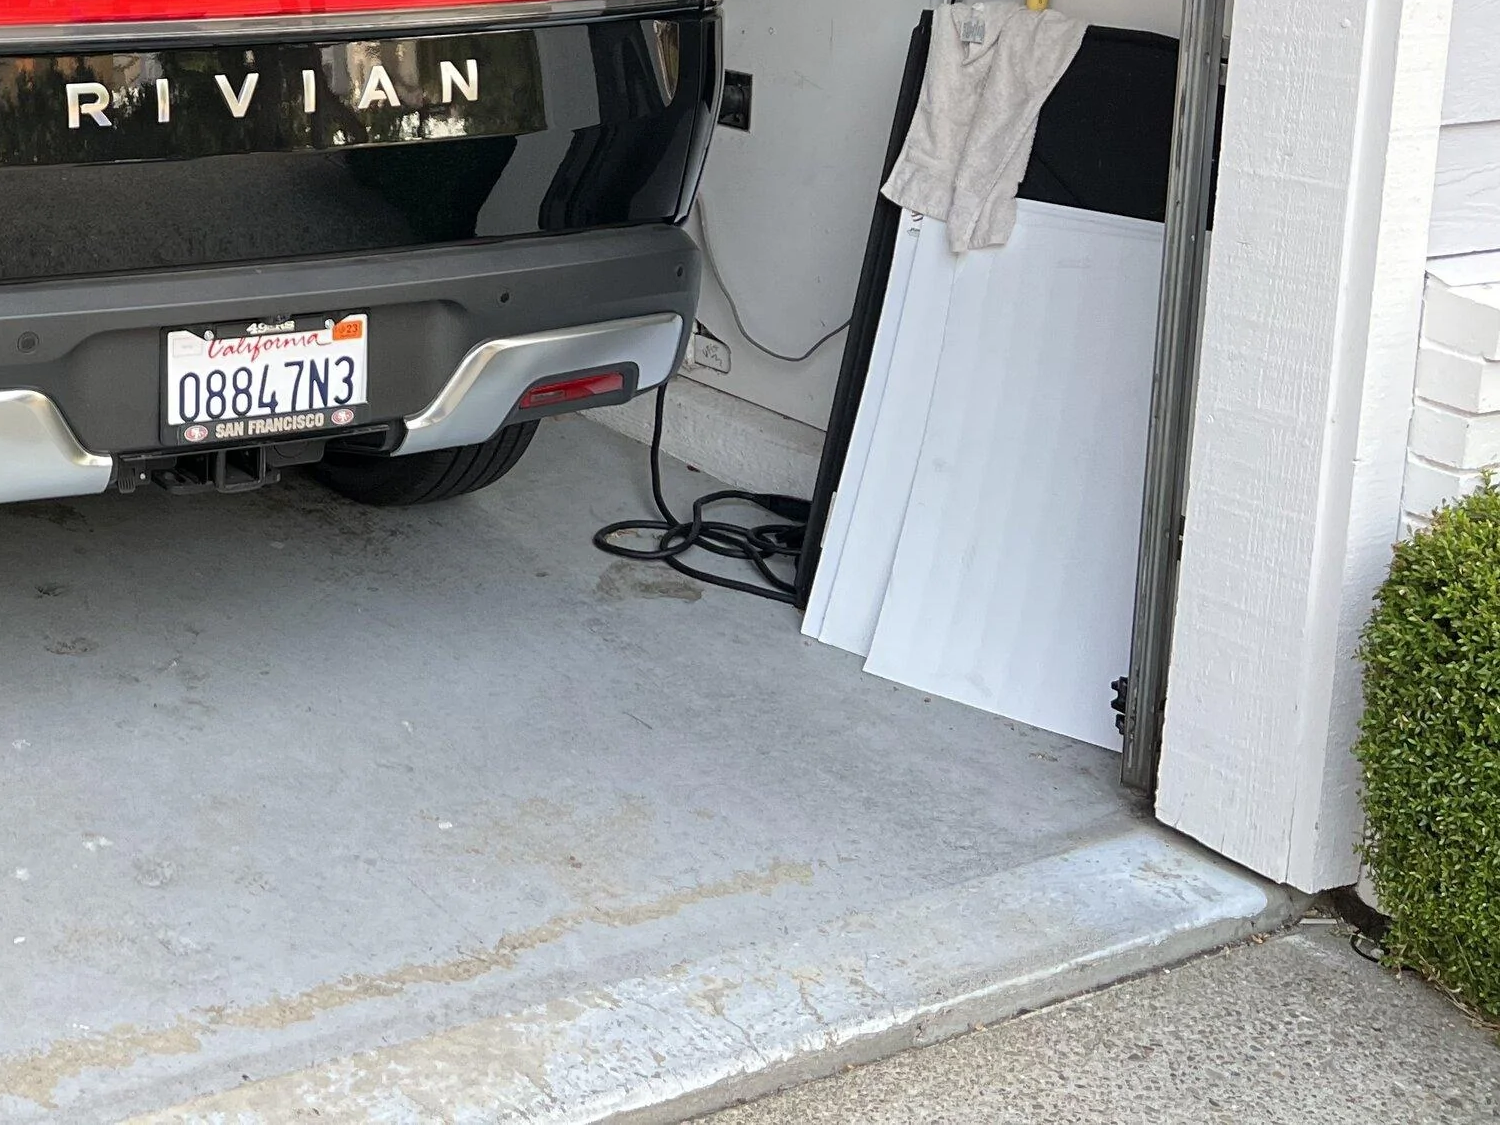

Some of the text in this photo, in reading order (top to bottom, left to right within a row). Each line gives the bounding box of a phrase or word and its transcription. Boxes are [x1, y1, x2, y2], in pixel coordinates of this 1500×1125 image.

[67, 59, 479, 129] RIVIAN
[346, 324, 359, 334] 23
[207, 332, 331, 362] California
[179, 355, 355, 423] 08847N3
[215, 412, 325, 438] SAN FRANCISCO
